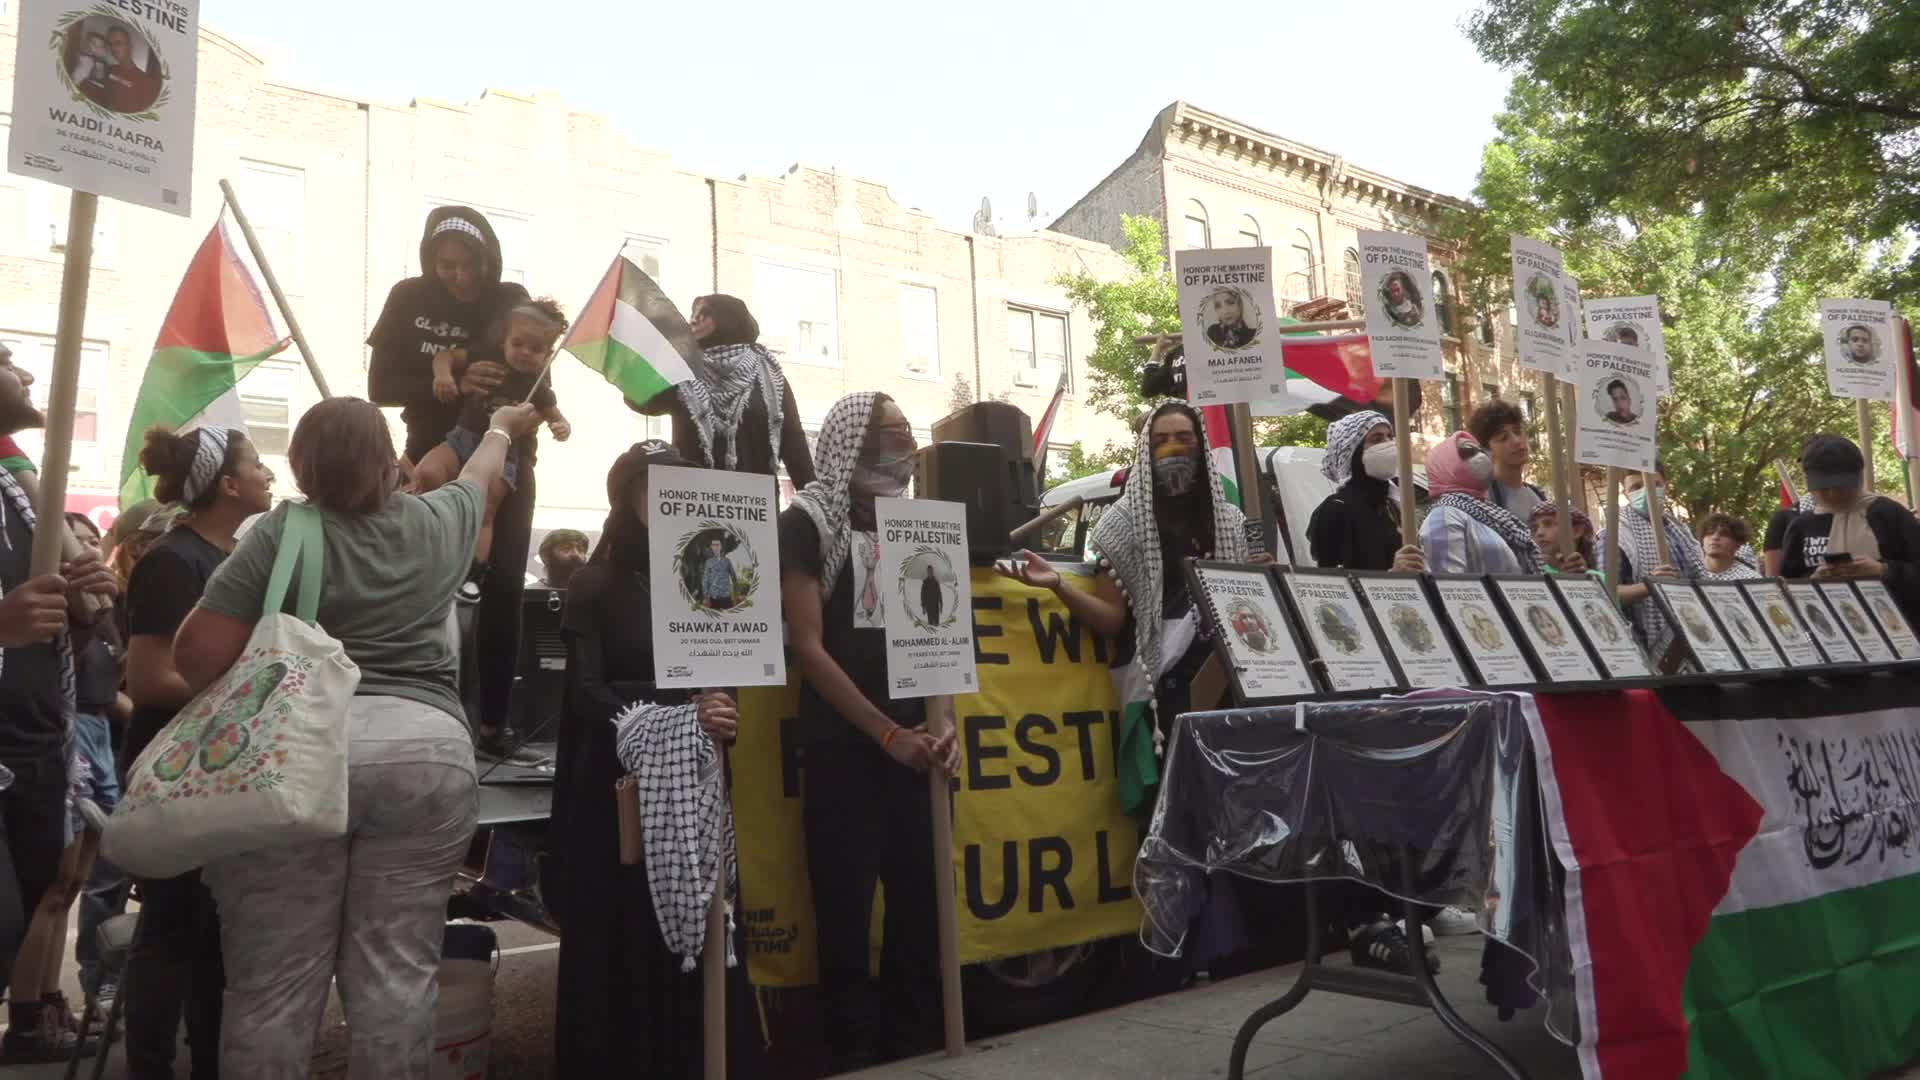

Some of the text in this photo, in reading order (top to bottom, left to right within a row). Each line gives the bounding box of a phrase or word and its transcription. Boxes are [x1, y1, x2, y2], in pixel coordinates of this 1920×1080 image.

[49, 106, 164, 152] WAJDI JAAFRA
[1366, 253, 1425, 270] OF PALESTINE
[1184, 263, 1265, 274] HONOR THE MARTYRS
[1184, 271, 1265, 286] OF PALESTINE
[1591, 311, 1654, 322] OF PALESTINE
[1207, 355, 1262, 367] MAI AFANEH
[1586, 359, 1651, 378] OF PALESTINE
[659, 488, 767, 506] HONOR THE MARTYRS
[660, 501, 767, 522] OF PALESTINE
[885, 519, 961, 531] HONOR THE MARTYRS
[886, 530, 961, 545] OF PALESTINE
[1209, 584, 1265, 597] OF PALESTINE
[1308, 589, 1349, 600] PALESTINE
[668, 621, 768, 633] SHAWKAT AWAD
[892, 638, 940, 648] MOHAMMED
